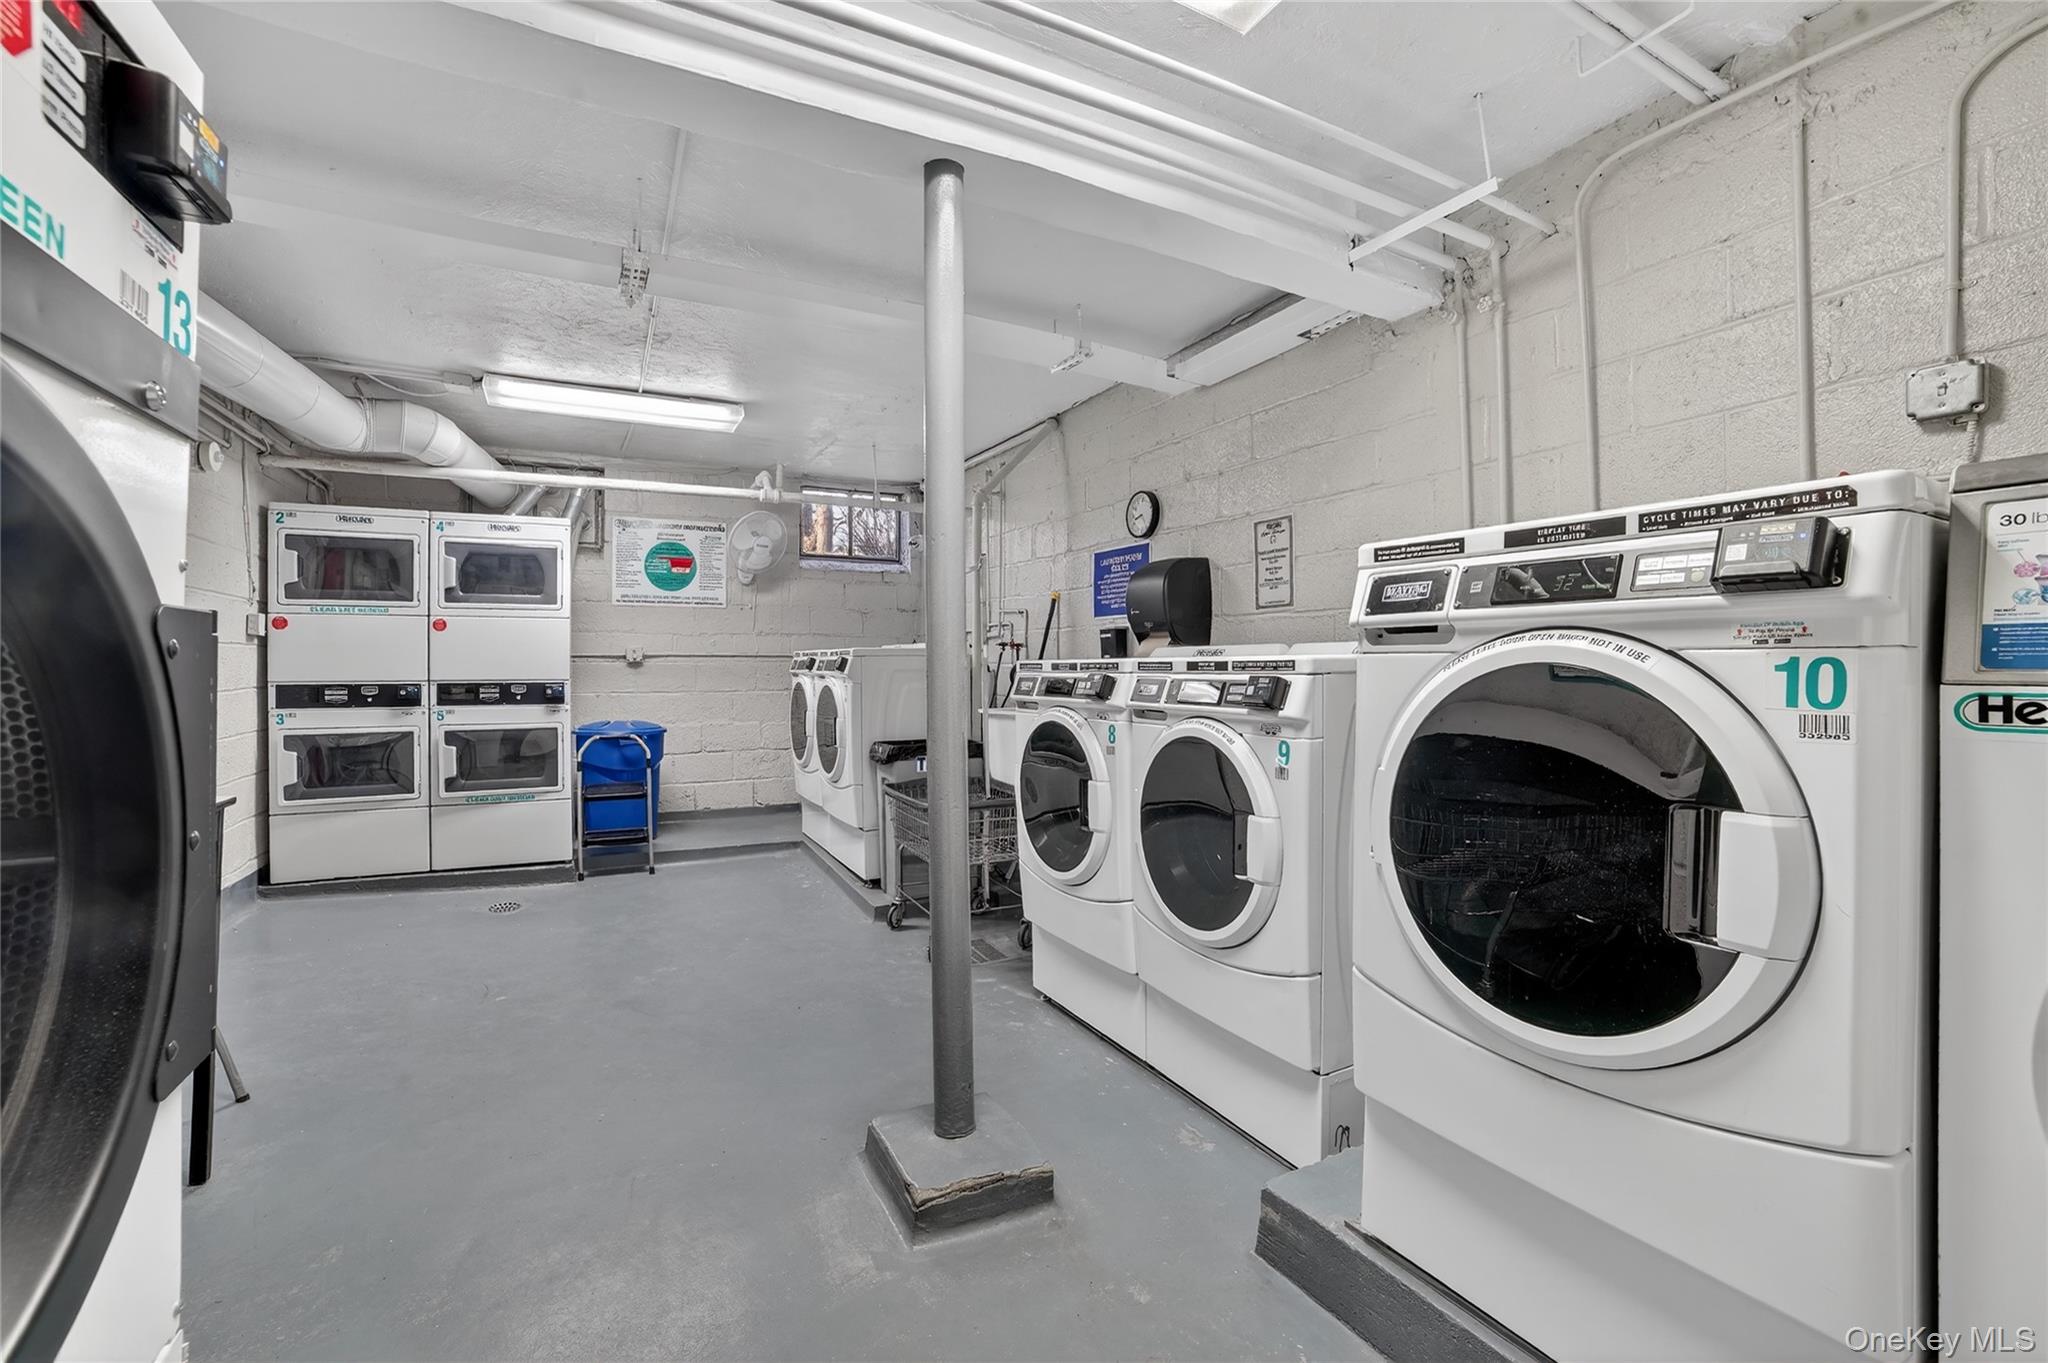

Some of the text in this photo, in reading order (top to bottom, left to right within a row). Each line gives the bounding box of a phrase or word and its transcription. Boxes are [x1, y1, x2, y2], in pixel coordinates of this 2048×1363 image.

[158, 278, 192, 358] 13
[276, 512, 285, 523] 2
[1643, 489, 1850, 524] CYCLE TIMES MAY VARY DUE TO:
[436, 521, 444, 532] 4
[2000, 513, 2027, 527] 30
[1528, 633, 1554, 642] OPEN
[1589, 637, 1613, 649] NOT
[1612, 643, 1627, 654] IN
[1626, 648, 1651, 664] USE
[1775, 656, 1848, 710] 10
[275, 713, 285, 725] 3
[436, 710, 445, 721] 5
[1978, 695, 2048, 725] He
[1108, 724, 1116, 744] 8
[1279, 740, 1290, 766] 9
